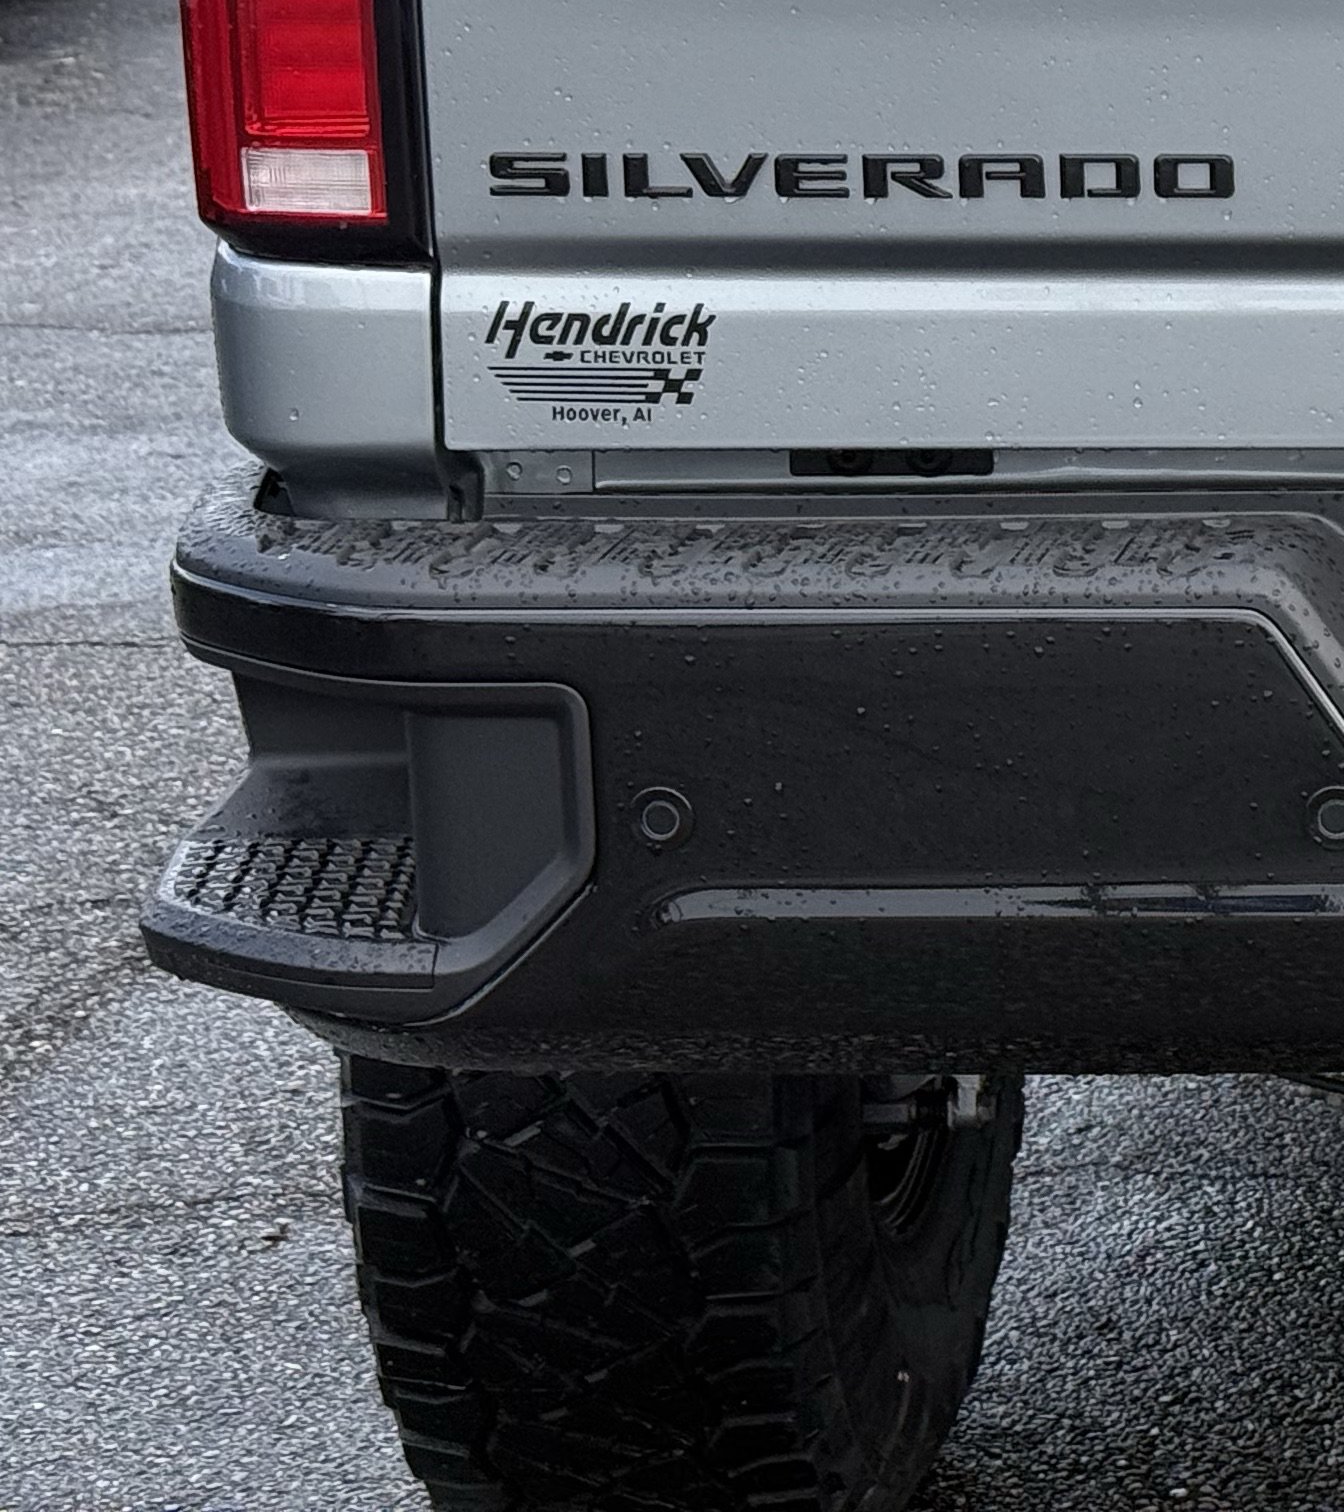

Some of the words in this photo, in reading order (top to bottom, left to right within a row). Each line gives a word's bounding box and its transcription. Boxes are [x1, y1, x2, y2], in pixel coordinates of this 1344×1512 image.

[488, 151, 1237, 199] SILVERADO
[485, 300, 718, 360] Hendrick
[579, 350, 707, 366] CHEVROLET
[551, 405, 629, 425] Hoover,
